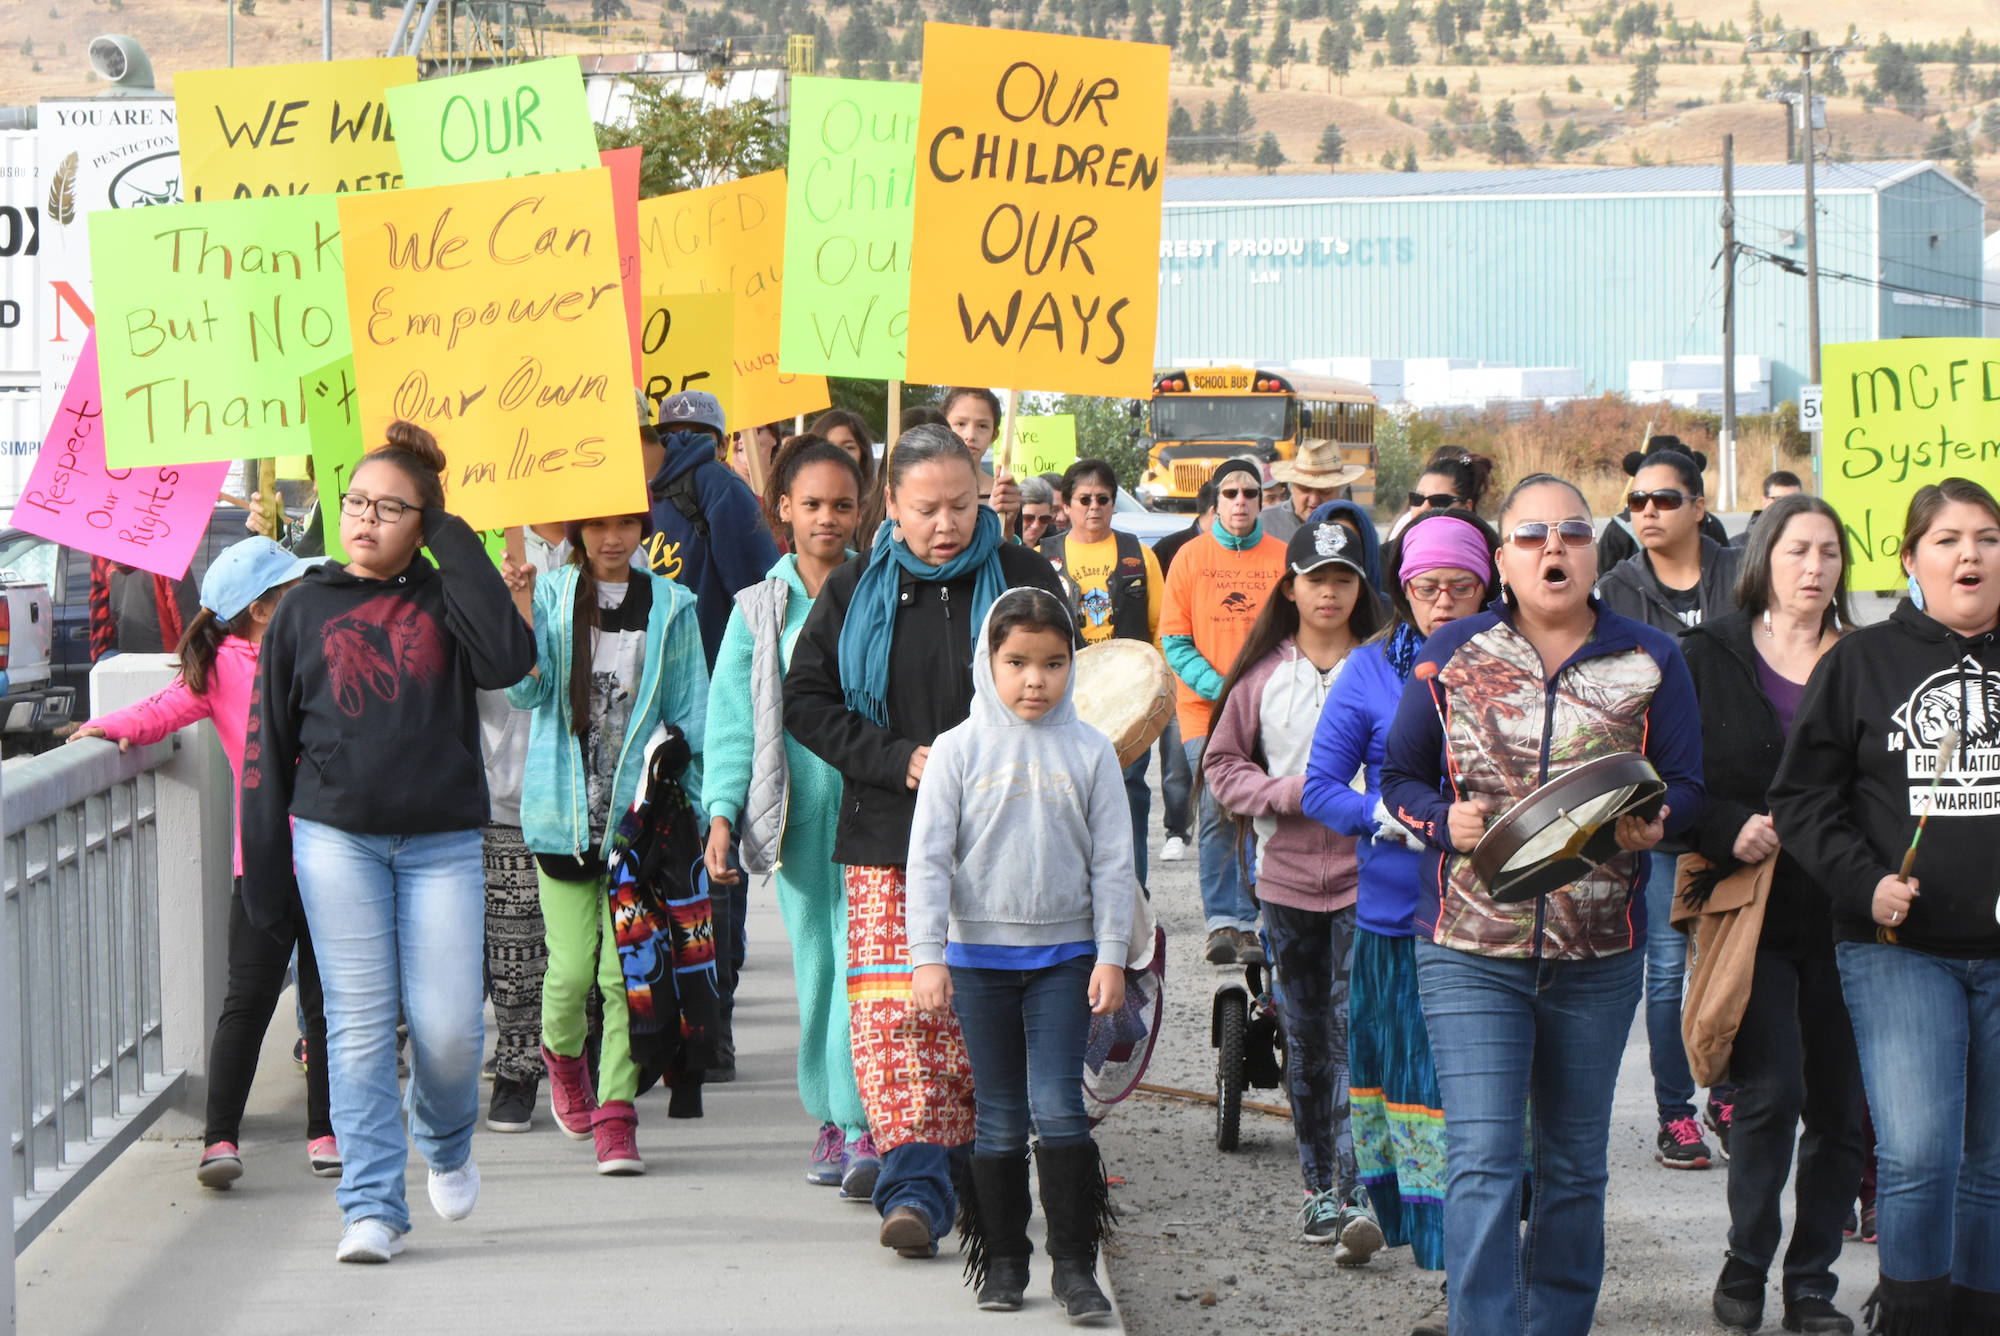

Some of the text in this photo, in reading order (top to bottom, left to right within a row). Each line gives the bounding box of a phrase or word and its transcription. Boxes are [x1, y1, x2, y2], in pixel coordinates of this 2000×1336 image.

[57, 108, 177, 126] YOU ARE N
[215, 100, 310, 148] WE
[441, 85, 542, 163] OUR
[997, 61, 1119, 127] OUR
[92, 135, 174, 168] PENTICTON
[929, 126, 1158, 191] CHILDREN
[383, 196, 592, 272] We Can
[981, 203, 1098, 276] OUR
[126, 295, 333, 362] But NO
[368, 283, 619, 350] Empower
[811, 295, 909, 360] Wa
[957, 289, 1131, 365] WAYS
[394, 369, 487, 422] Our
[499, 356, 608, 412] Own
[1194, 375, 1248, 389] SCHOOL BUS
[1804, 398, 1822, 418] 5
[26, 400, 103, 515] Respect
[1034, 455, 1057, 473] Our
[86, 488, 119, 529] Our
[119, 467, 179, 547] Rights
[1203, 568, 1241, 578] EVERY
[1216, 582, 1267, 590] MATTERS
[1887, 731, 1904, 751] 14
[1915, 754, 1956, 772] FIRT
